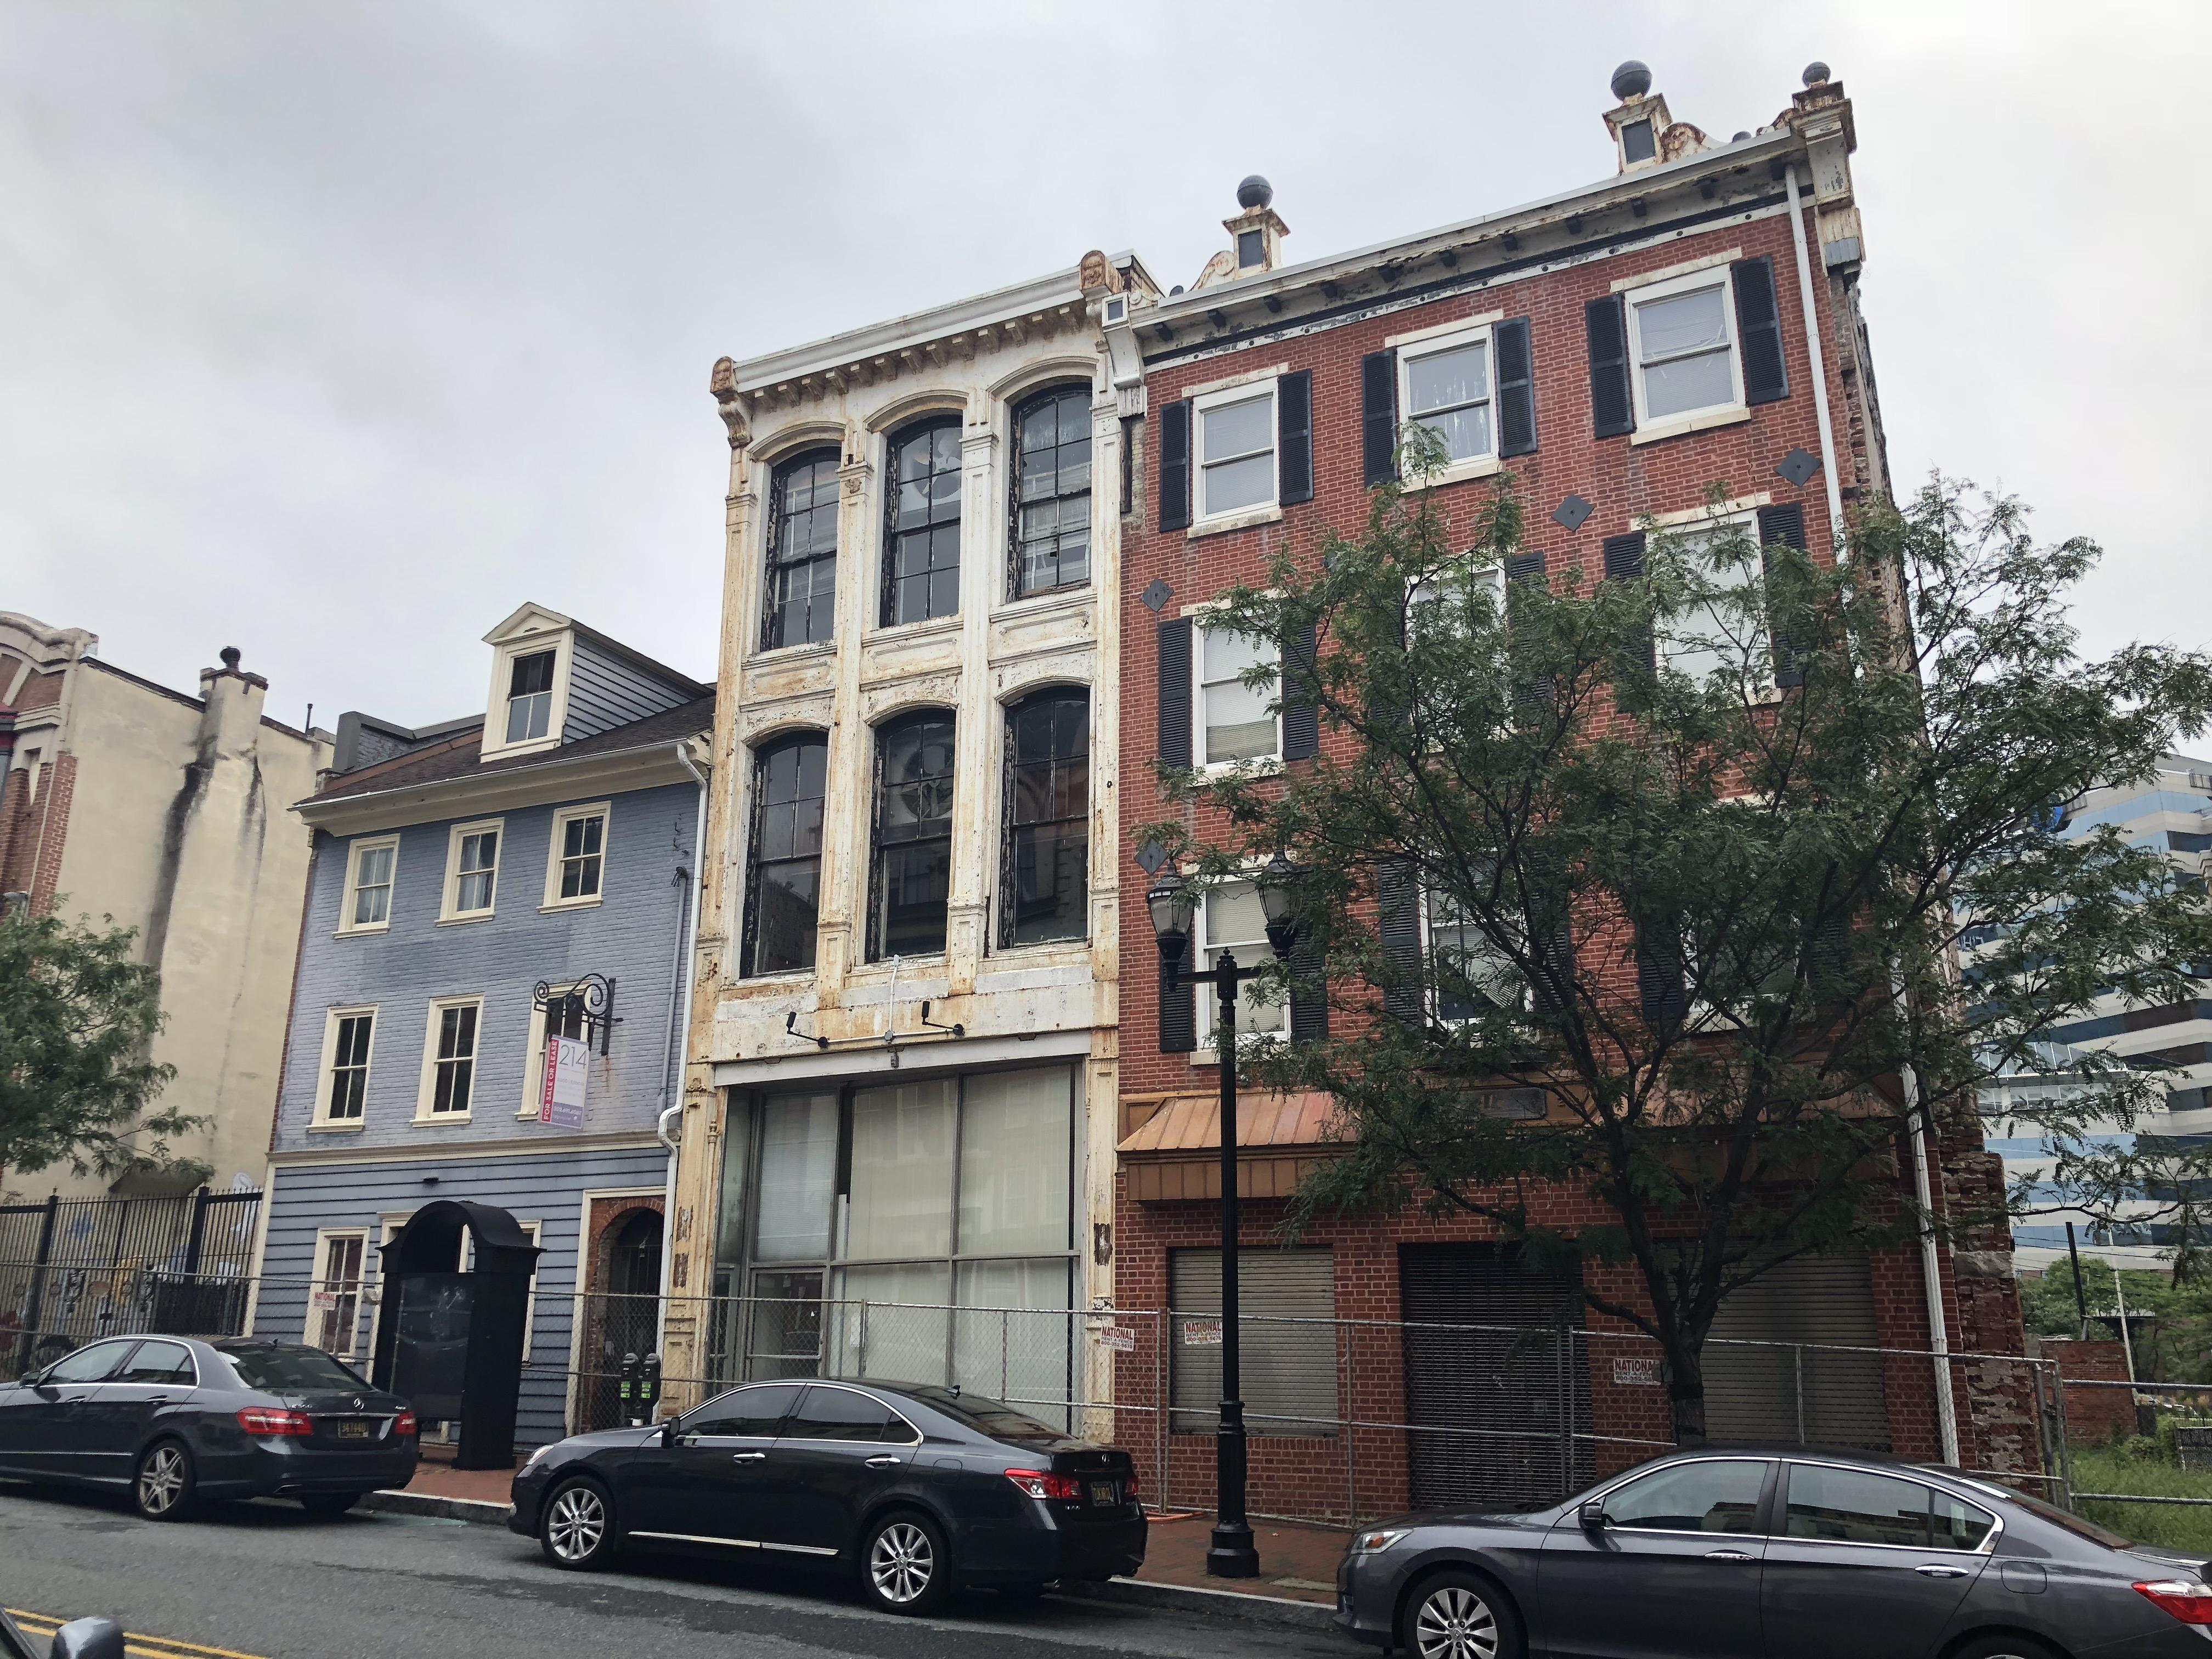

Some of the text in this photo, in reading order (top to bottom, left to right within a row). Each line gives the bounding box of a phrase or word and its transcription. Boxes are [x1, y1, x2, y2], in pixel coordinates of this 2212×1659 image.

[550, 1041, 558, 1065] LEASE
[559, 1044, 586, 1069] 214
[549, 1068, 555, 1080] OR
[545, 1080, 554, 1101] SALE
[315, 1293, 334, 1301] NATIONAL
[1102, 1326, 1133, 1340] NATIONAL
[1185, 1321, 1222, 1333] NATIONAL
[1615, 1359, 1653, 1372] NATIONA
